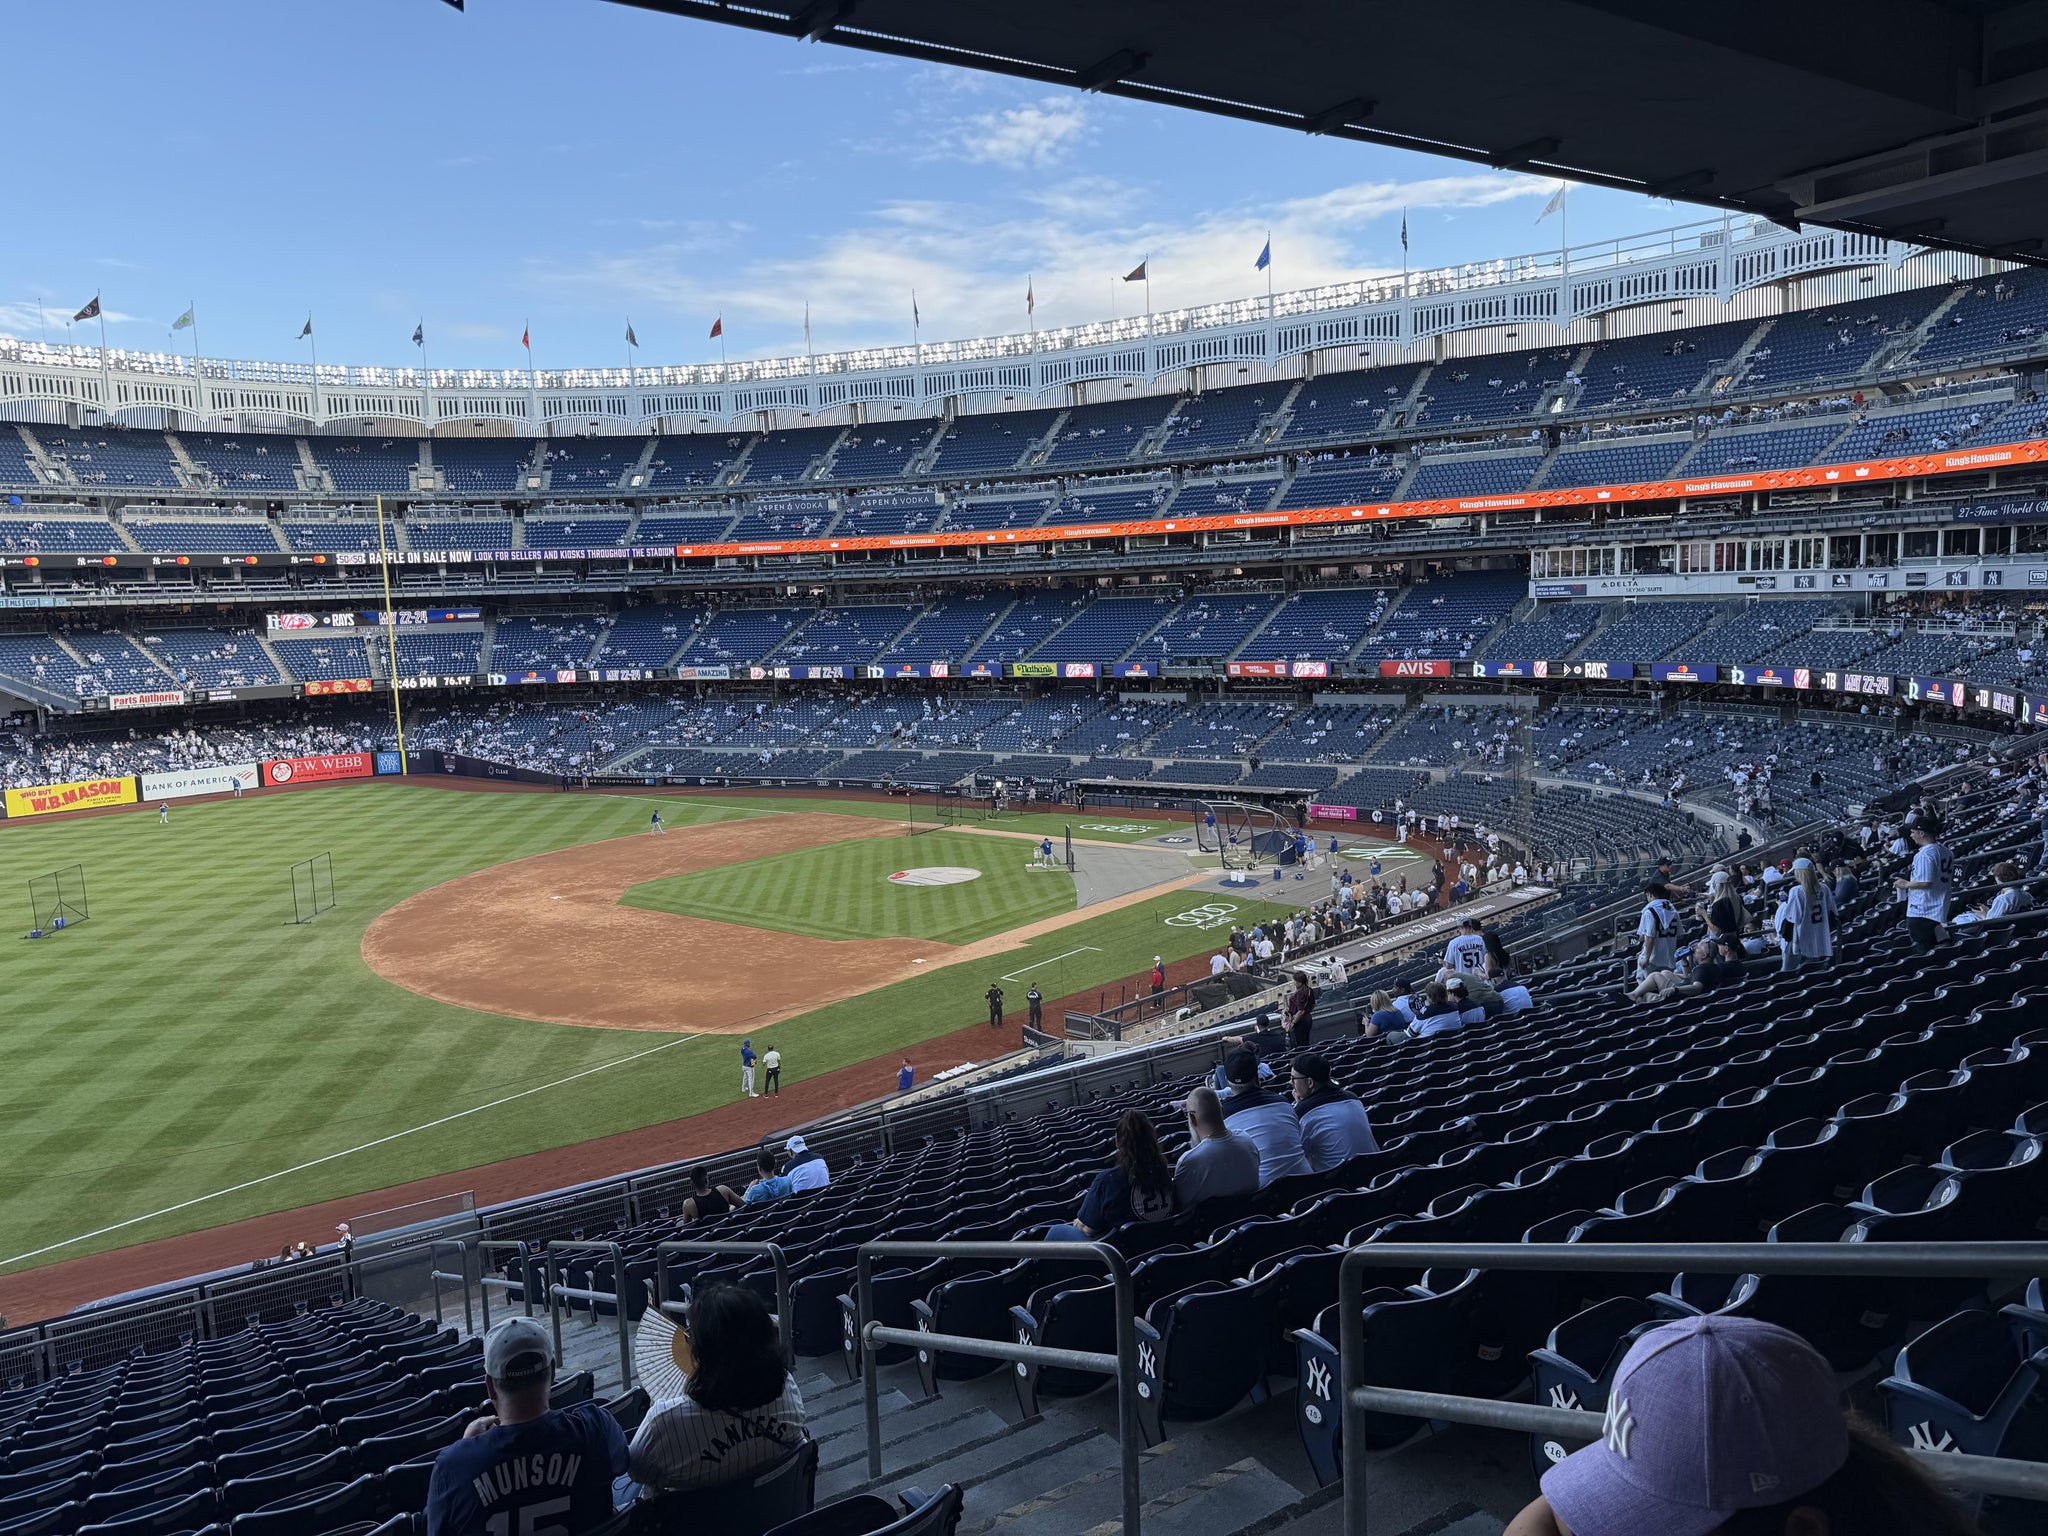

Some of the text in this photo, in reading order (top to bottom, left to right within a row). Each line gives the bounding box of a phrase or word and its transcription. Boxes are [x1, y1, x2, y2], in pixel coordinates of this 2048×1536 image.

[1945, 451, 2012, 467] King's Hawaiian
[1685, 480, 1752, 492] King's Hawaiian
[757, 504, 785, 512] ASPEN
[860, 496, 930, 506] ASPEN VODKA
[1459, 498, 1525, 510] King's Hawaiian
[1958, 505, 1998, 518] 27-Time
[2000, 502, 2034, 514] World
[1254, 515, 1289, 524] Hawaiian
[1082, 527, 1111, 535] Hawaiian
[369, 550, 471, 564] RAFFLE ON SALE NOW
[474, 547, 675, 560] LOOK FOR SELLERS AND KIOSKS THROUGHOUT THE STADIUM
[1868, 577, 1886, 587] WFAN
[2032, 572, 2045, 580] YES
[332, 613, 355, 627] RAYS
[399, 611, 428, 624] 22-24
[589, 670, 599, 681] TB
[697, 669, 728, 677] AMAZING
[774, 667, 790, 679] RAYS
[1017, 664, 1053, 674] Nathan's
[1396, 662, 1434, 675] AVIS
[1585, 662, 1607, 678] RAYS
[419, 676, 437, 688] PM
[443, 675, 471, 686] 76.1°F
[1825, 672, 1889, 695] TB MAY 22-24
[113, 692, 180, 706] Parts Authority
[1979, 690, 1988, 707] TB
[294, 756, 362, 772] F.W. WEBB
[145, 782, 173, 792] BANK
[190, 776, 236, 786] AMERICA
[20, 790, 37, 799] WHO
[31, 781, 122, 812] W.B.MASON
[1811, 904, 1822, 924] 2
[1197, 916, 1237, 930] Audi
[1360, 929, 1411, 949] Welcome
[1452, 904, 1496, 921] Stadium
[1458, 943, 1483, 953] WILLIAMS
[1463, 952, 1480, 968] 51
[1319, 972, 1329, 980] 99
[843, 1311, 855, 1337] NY
[1137, 1341, 1158, 1379] NY
[1306, 1356, 1332, 1401] NY
[1601, 1389, 1635, 1459] NY
[701, 1415, 788, 1464] YANKEES
[1549, 1446, 1561, 1458] 16
[472, 1452, 582, 1508] MUNSON
